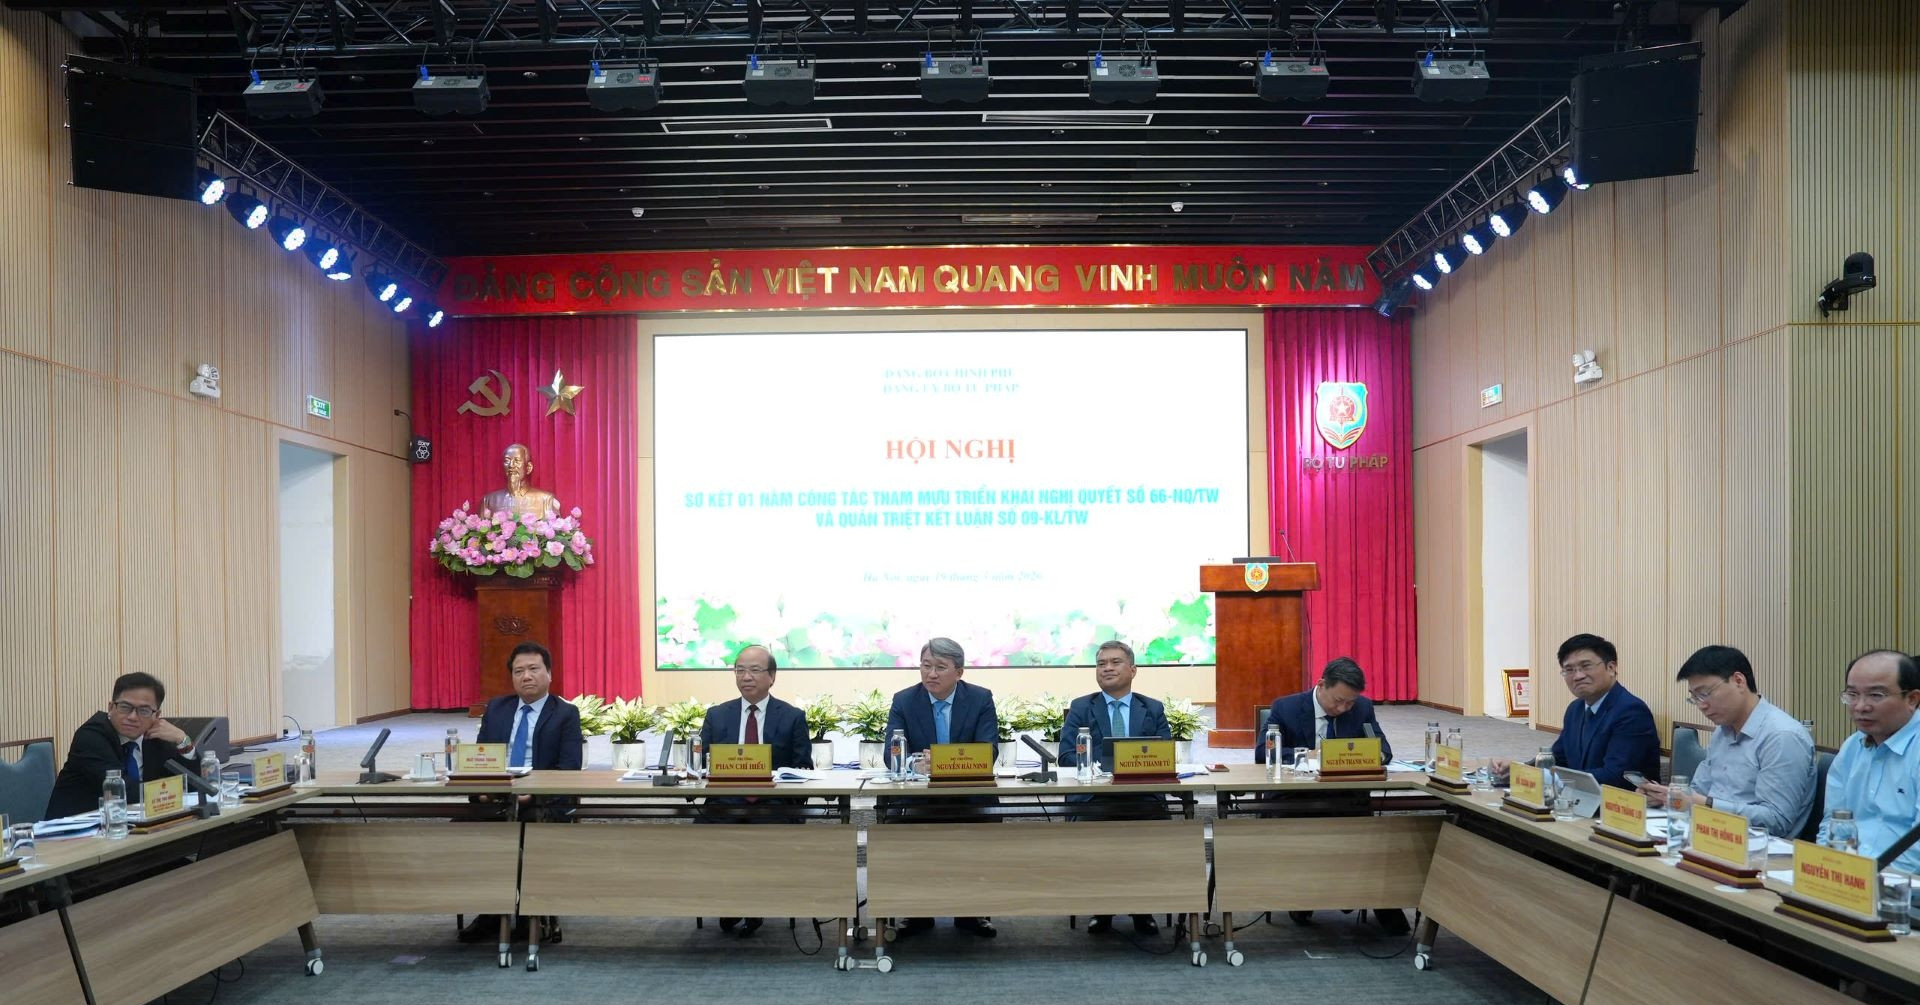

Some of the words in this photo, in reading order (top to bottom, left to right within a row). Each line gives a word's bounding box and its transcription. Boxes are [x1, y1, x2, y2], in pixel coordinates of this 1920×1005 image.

[455, 263, 555, 301] ĐẢNG
[568, 264, 670, 304] CỘNG
[681, 258, 753, 296] SẢN
[762, 259, 839, 301] VIỆT
[850, 265, 924, 294] NAM
[933, 264, 1060, 293] QUANG
[1075, 264, 1158, 293] VINH
[1172, 255, 1275, 293] MUÔN
[1289, 257, 1365, 292] NĂM
[886, 436, 937, 464] HỘI
[945, 438, 1016, 464] NGHỊ
[738, 492, 754, 506] 01
[798, 488, 837, 506] CÔNG
[842, 488, 868, 506] TÁC
[873, 490, 913, 505] THAM
[1001, 489, 1034, 504] KHAI
[1127, 485, 1146, 504] SỐ
[1150, 488, 1220, 505] 66-NQ/TW
[1021, 508, 1089, 525] 09-KL/TW
[735, 762, 748, 770] CHÍ
[749, 761, 766, 770] HIẾU
[936, 760, 960, 770] NGUYỄN
[1801, 861, 1829, 880] NGUYỄN
[1831, 870, 1842, 886] THỊ
[1844, 873, 1866, 891] HẠNH
